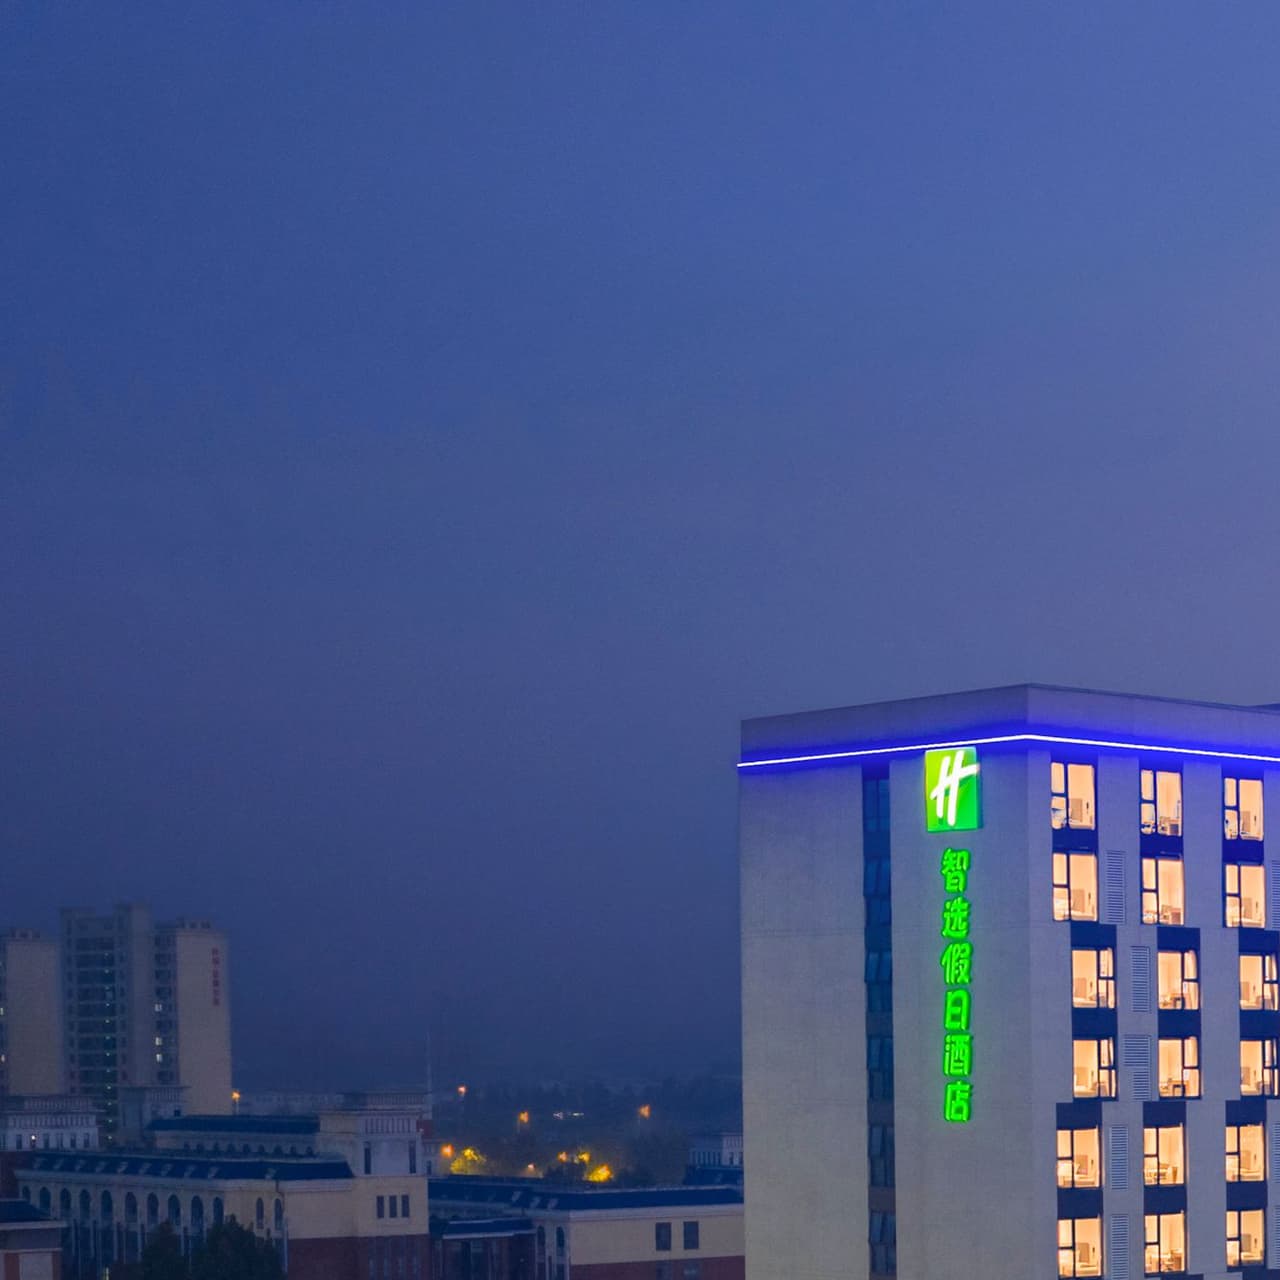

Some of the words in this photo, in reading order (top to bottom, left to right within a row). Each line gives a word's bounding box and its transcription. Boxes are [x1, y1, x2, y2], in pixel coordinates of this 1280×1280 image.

[940, 847, 972, 1123] 智选假日酒店
